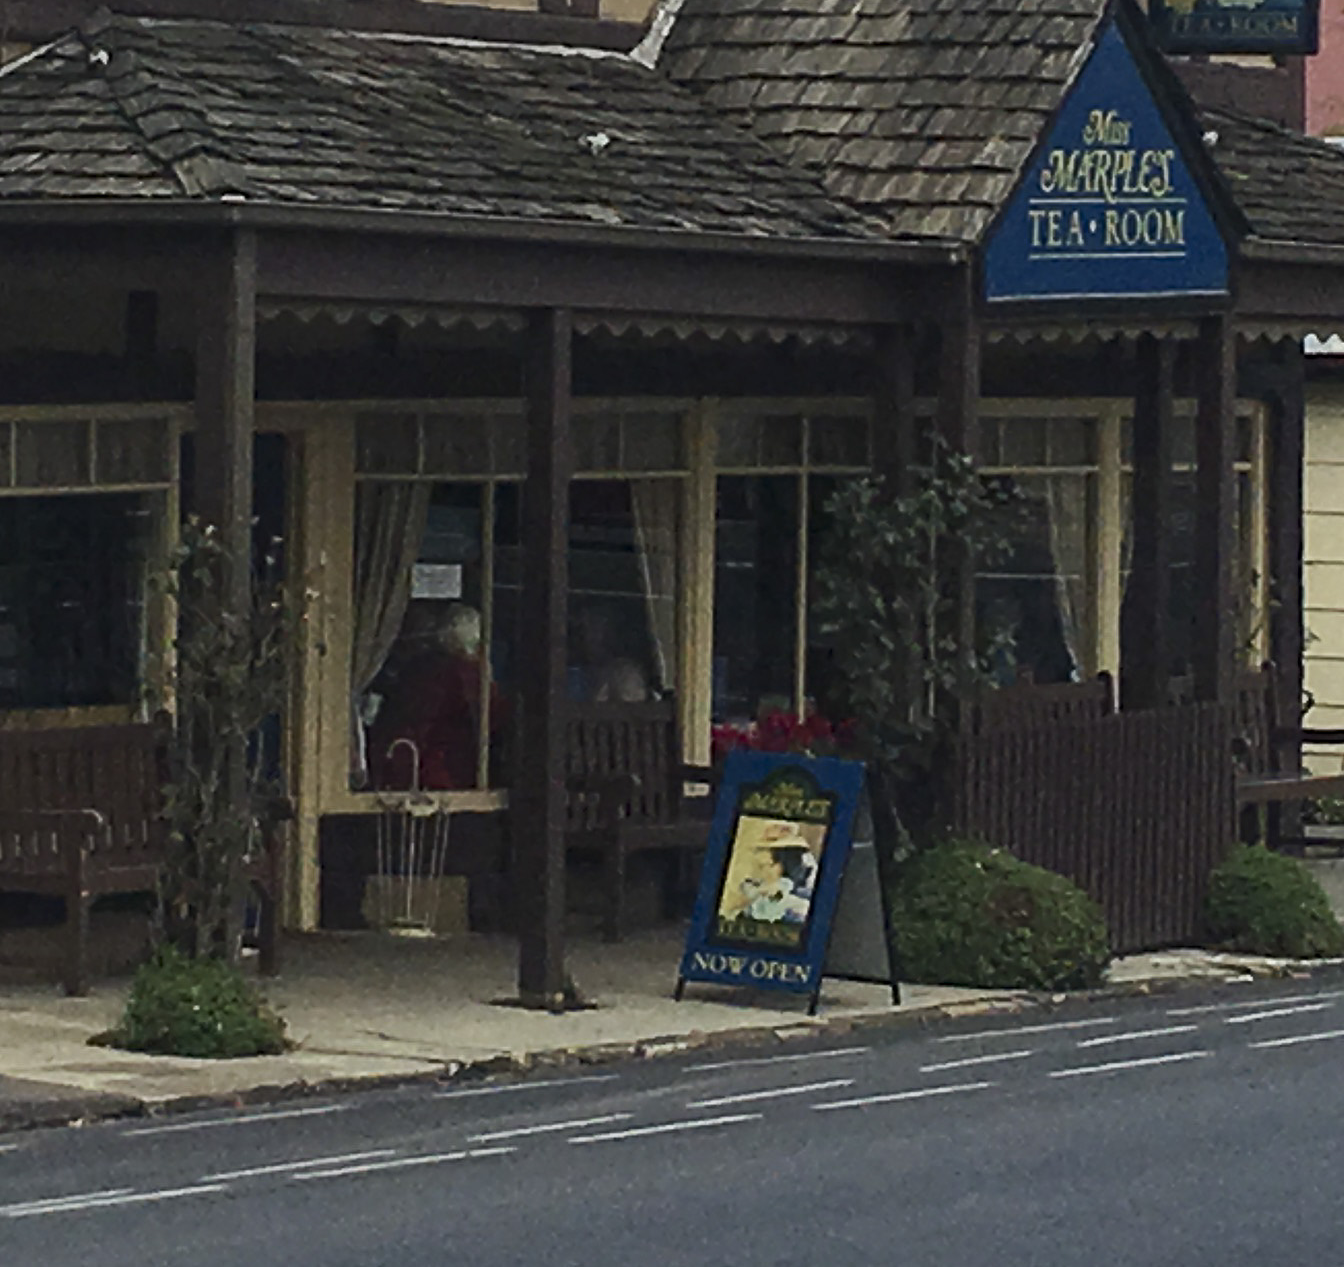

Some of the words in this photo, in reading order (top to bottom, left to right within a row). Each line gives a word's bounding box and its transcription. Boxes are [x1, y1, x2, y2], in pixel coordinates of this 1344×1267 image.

[1105, 209, 1185, 245] ROOM
[691, 951, 747, 974] NOW
[749, 958, 812, 984] OPEN
